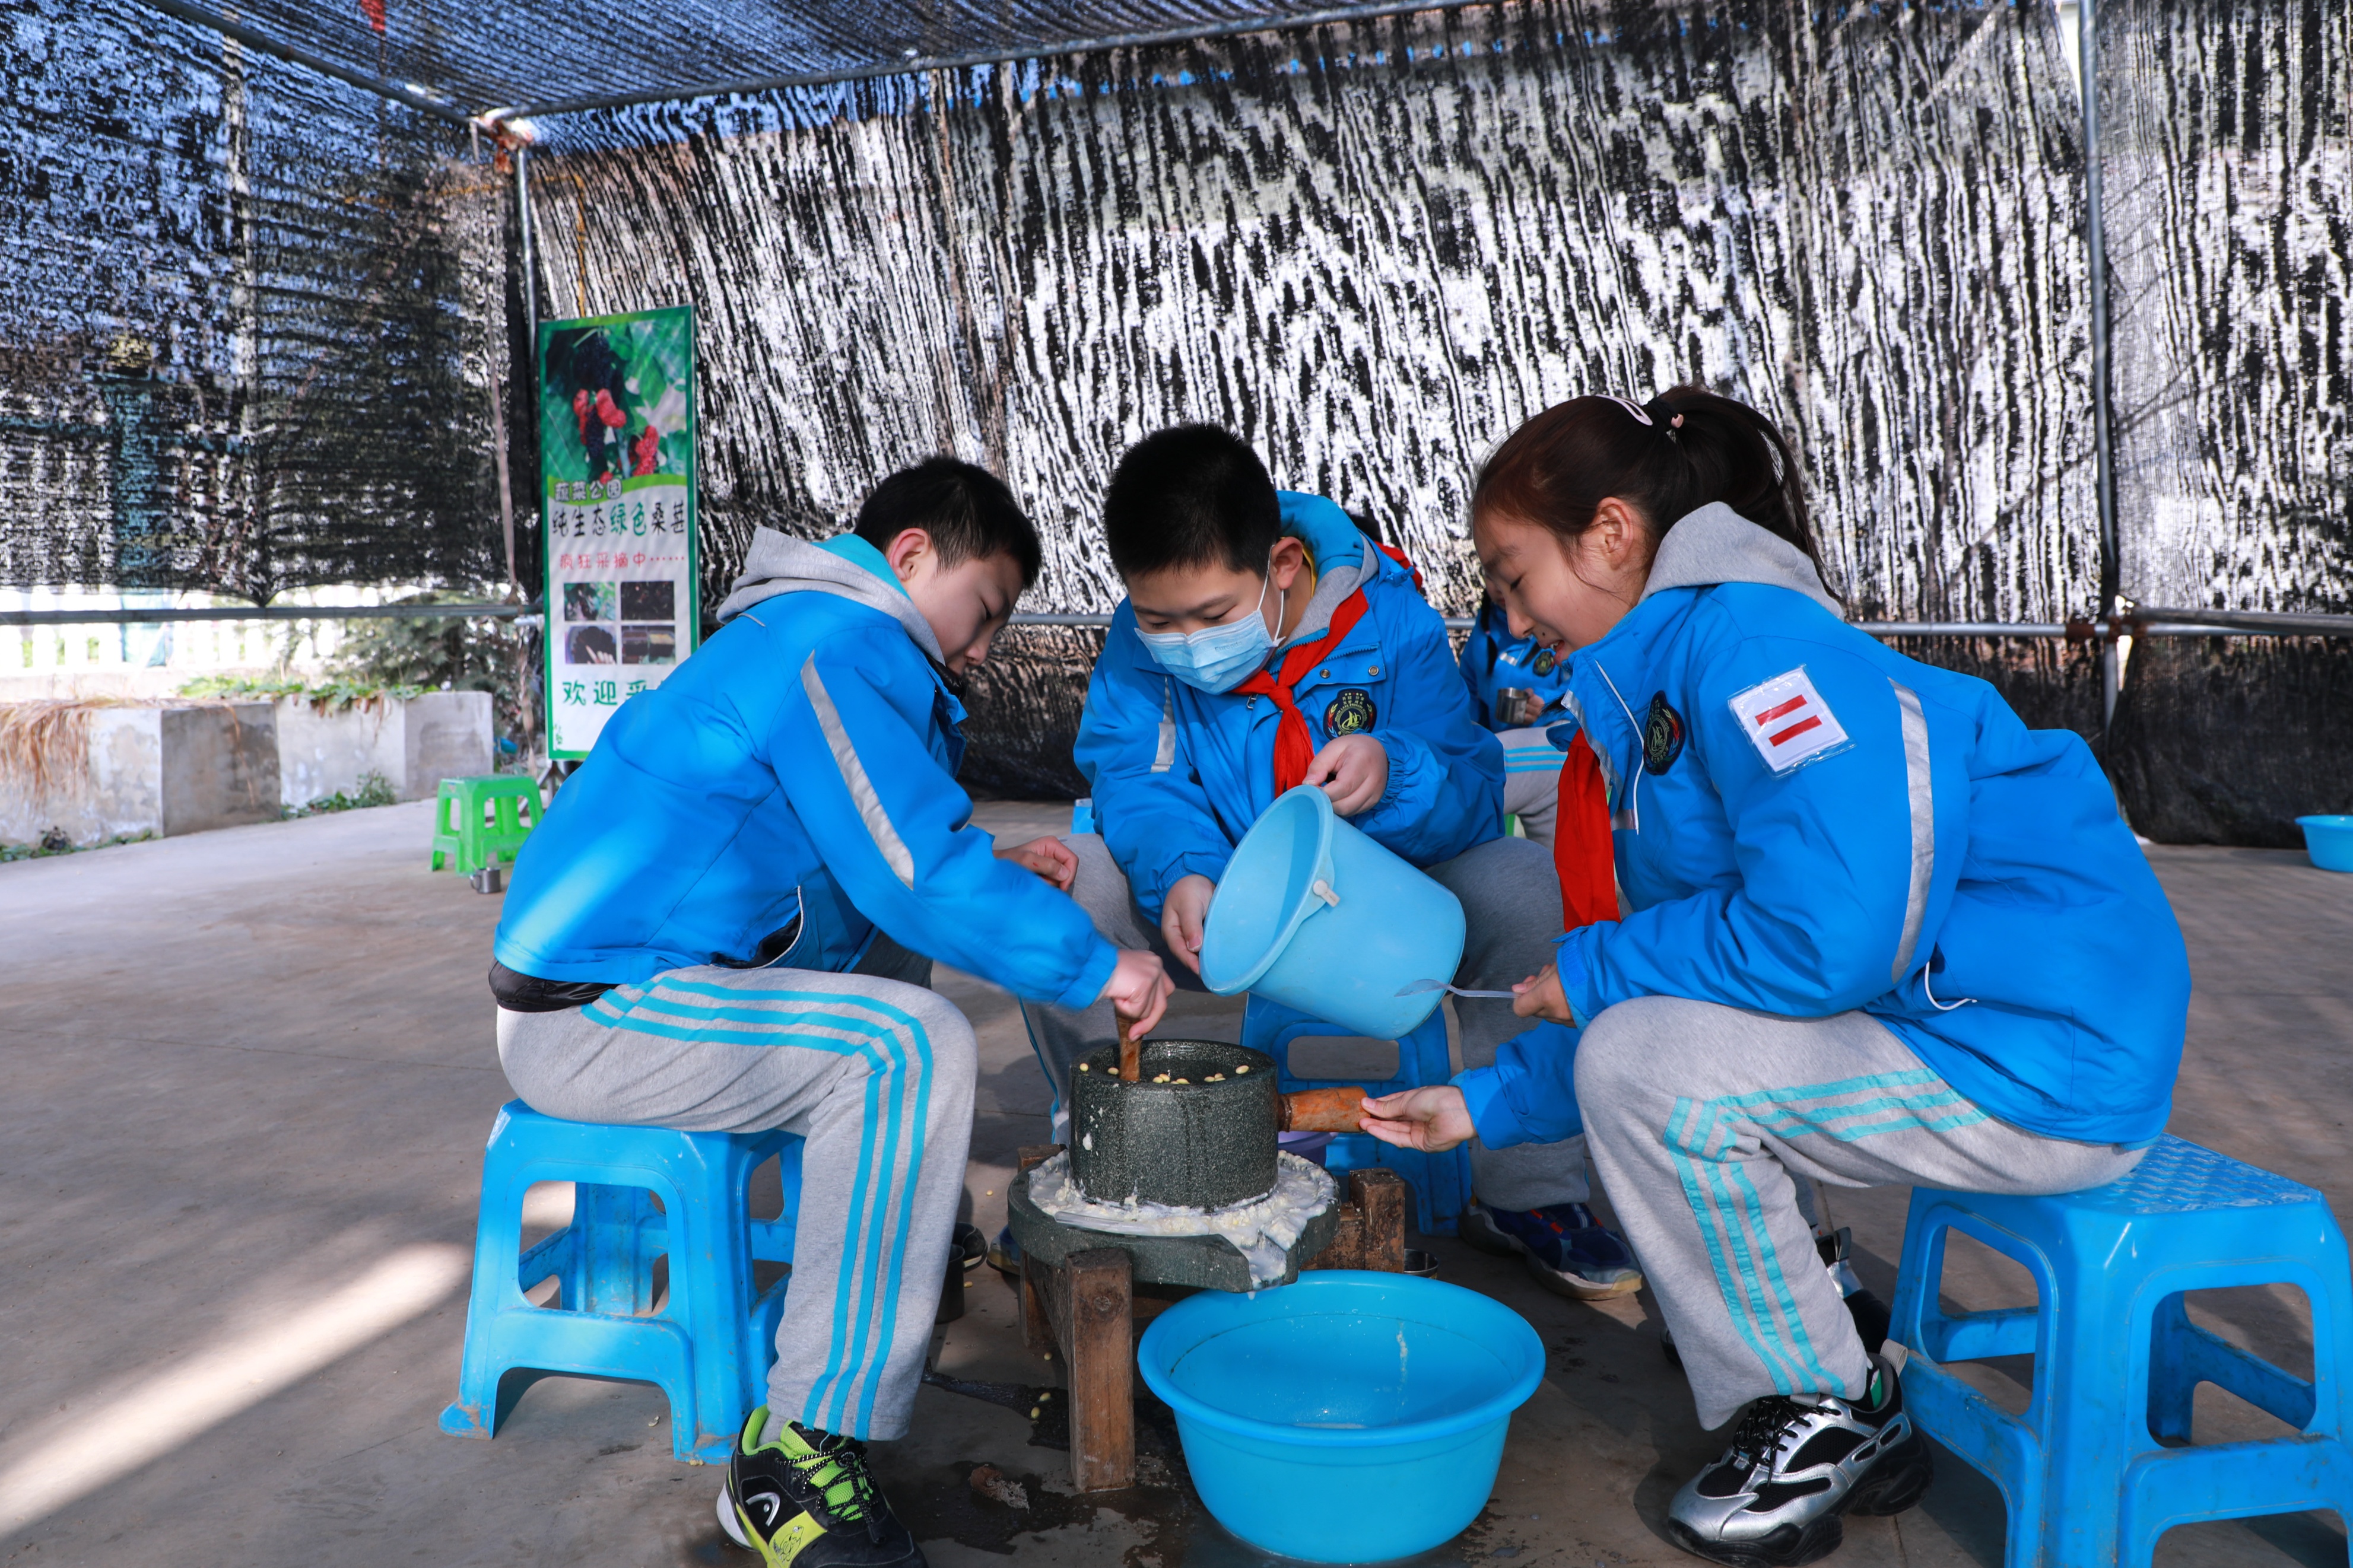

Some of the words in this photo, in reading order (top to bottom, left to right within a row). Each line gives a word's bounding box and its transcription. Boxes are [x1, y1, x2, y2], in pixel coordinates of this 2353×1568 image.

[552, 500, 685, 537] 纯生态绿色桑葚
[563, 680, 664, 706] 欢迎采
